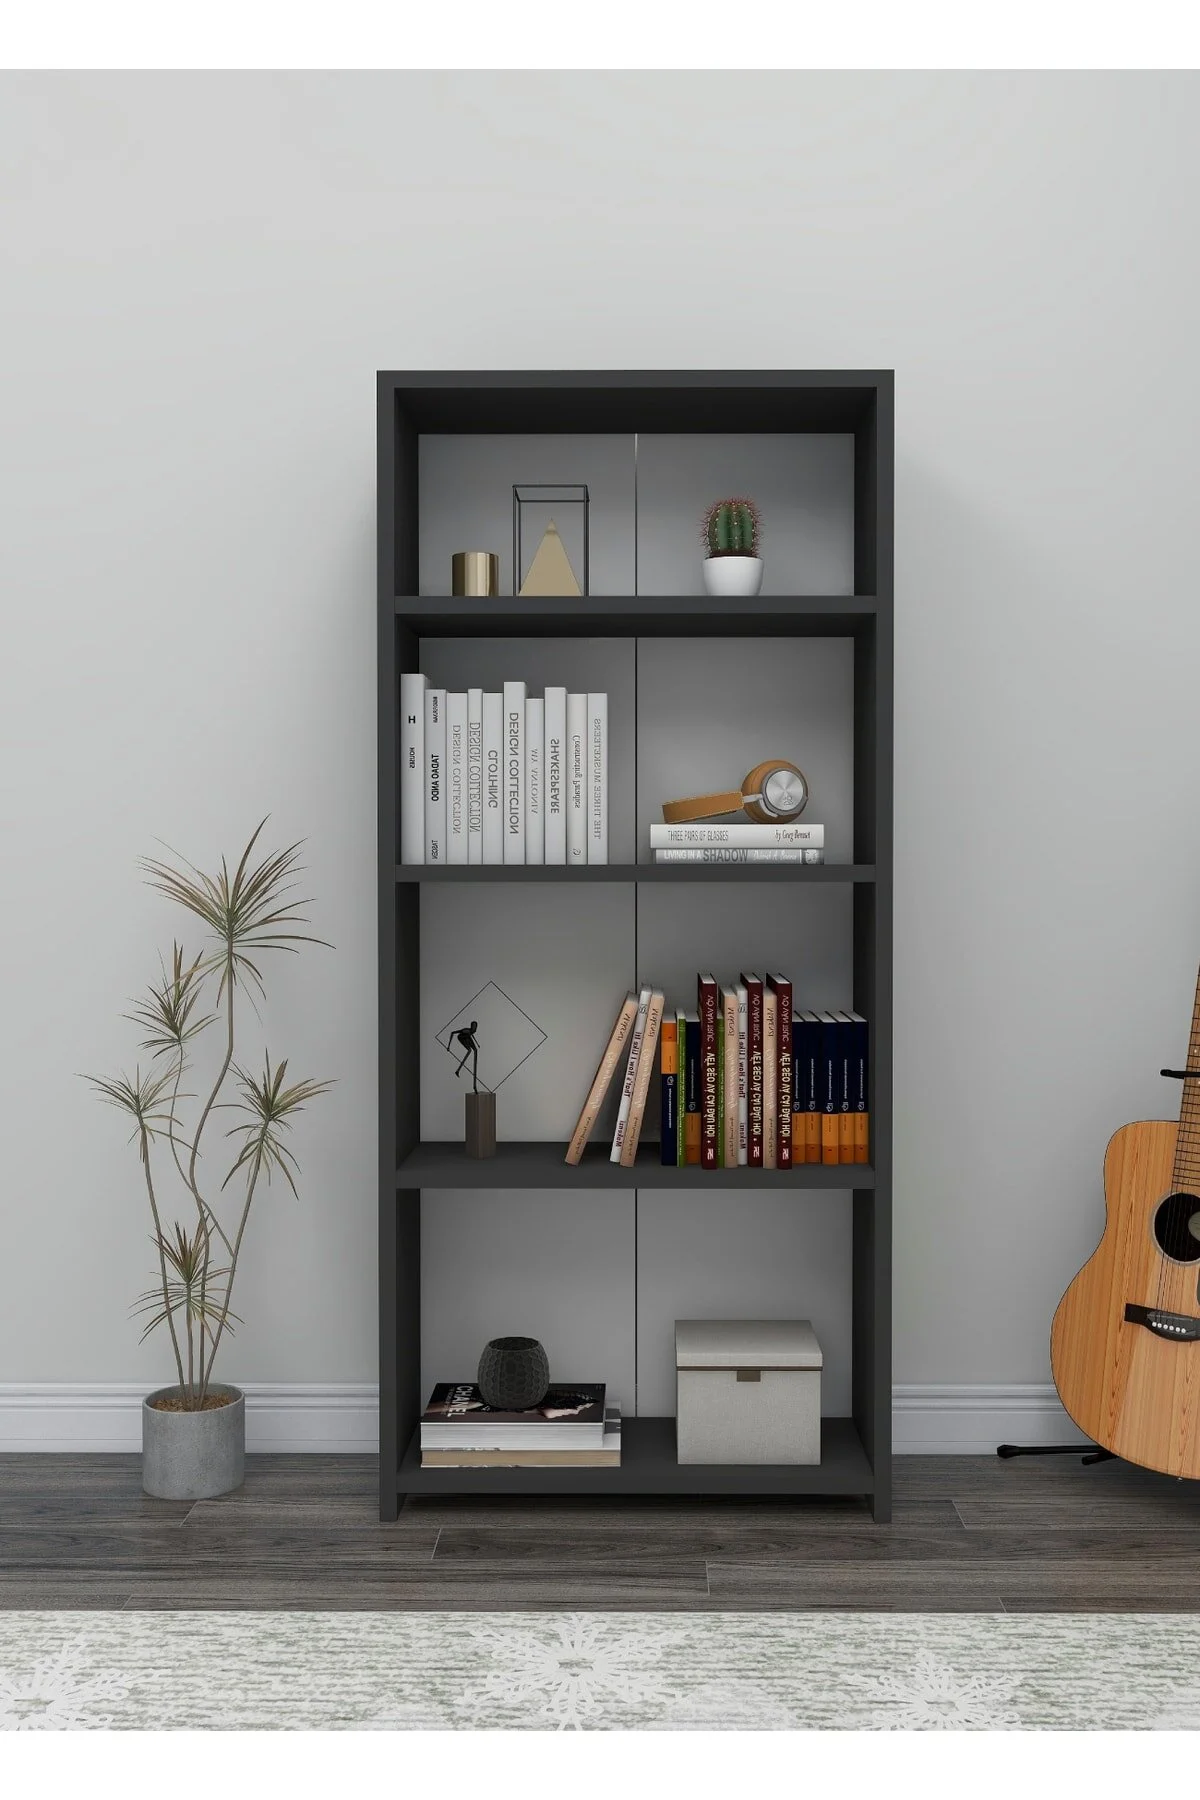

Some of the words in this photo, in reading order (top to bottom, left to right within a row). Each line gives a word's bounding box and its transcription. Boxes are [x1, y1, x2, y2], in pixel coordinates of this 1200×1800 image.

[668, 830, 683, 841] THREE
[684, 830, 698, 841] PAIRS
[700, 830, 706, 841] OF
[708, 830, 729, 841] GLASSES
[664, 849, 686, 860] LIVING
[688, 850, 696, 859] IN
[696, 850, 702, 859] A
[703, 849, 748, 863] SHADOW
[447, 1385, 473, 1417] CHANEL
